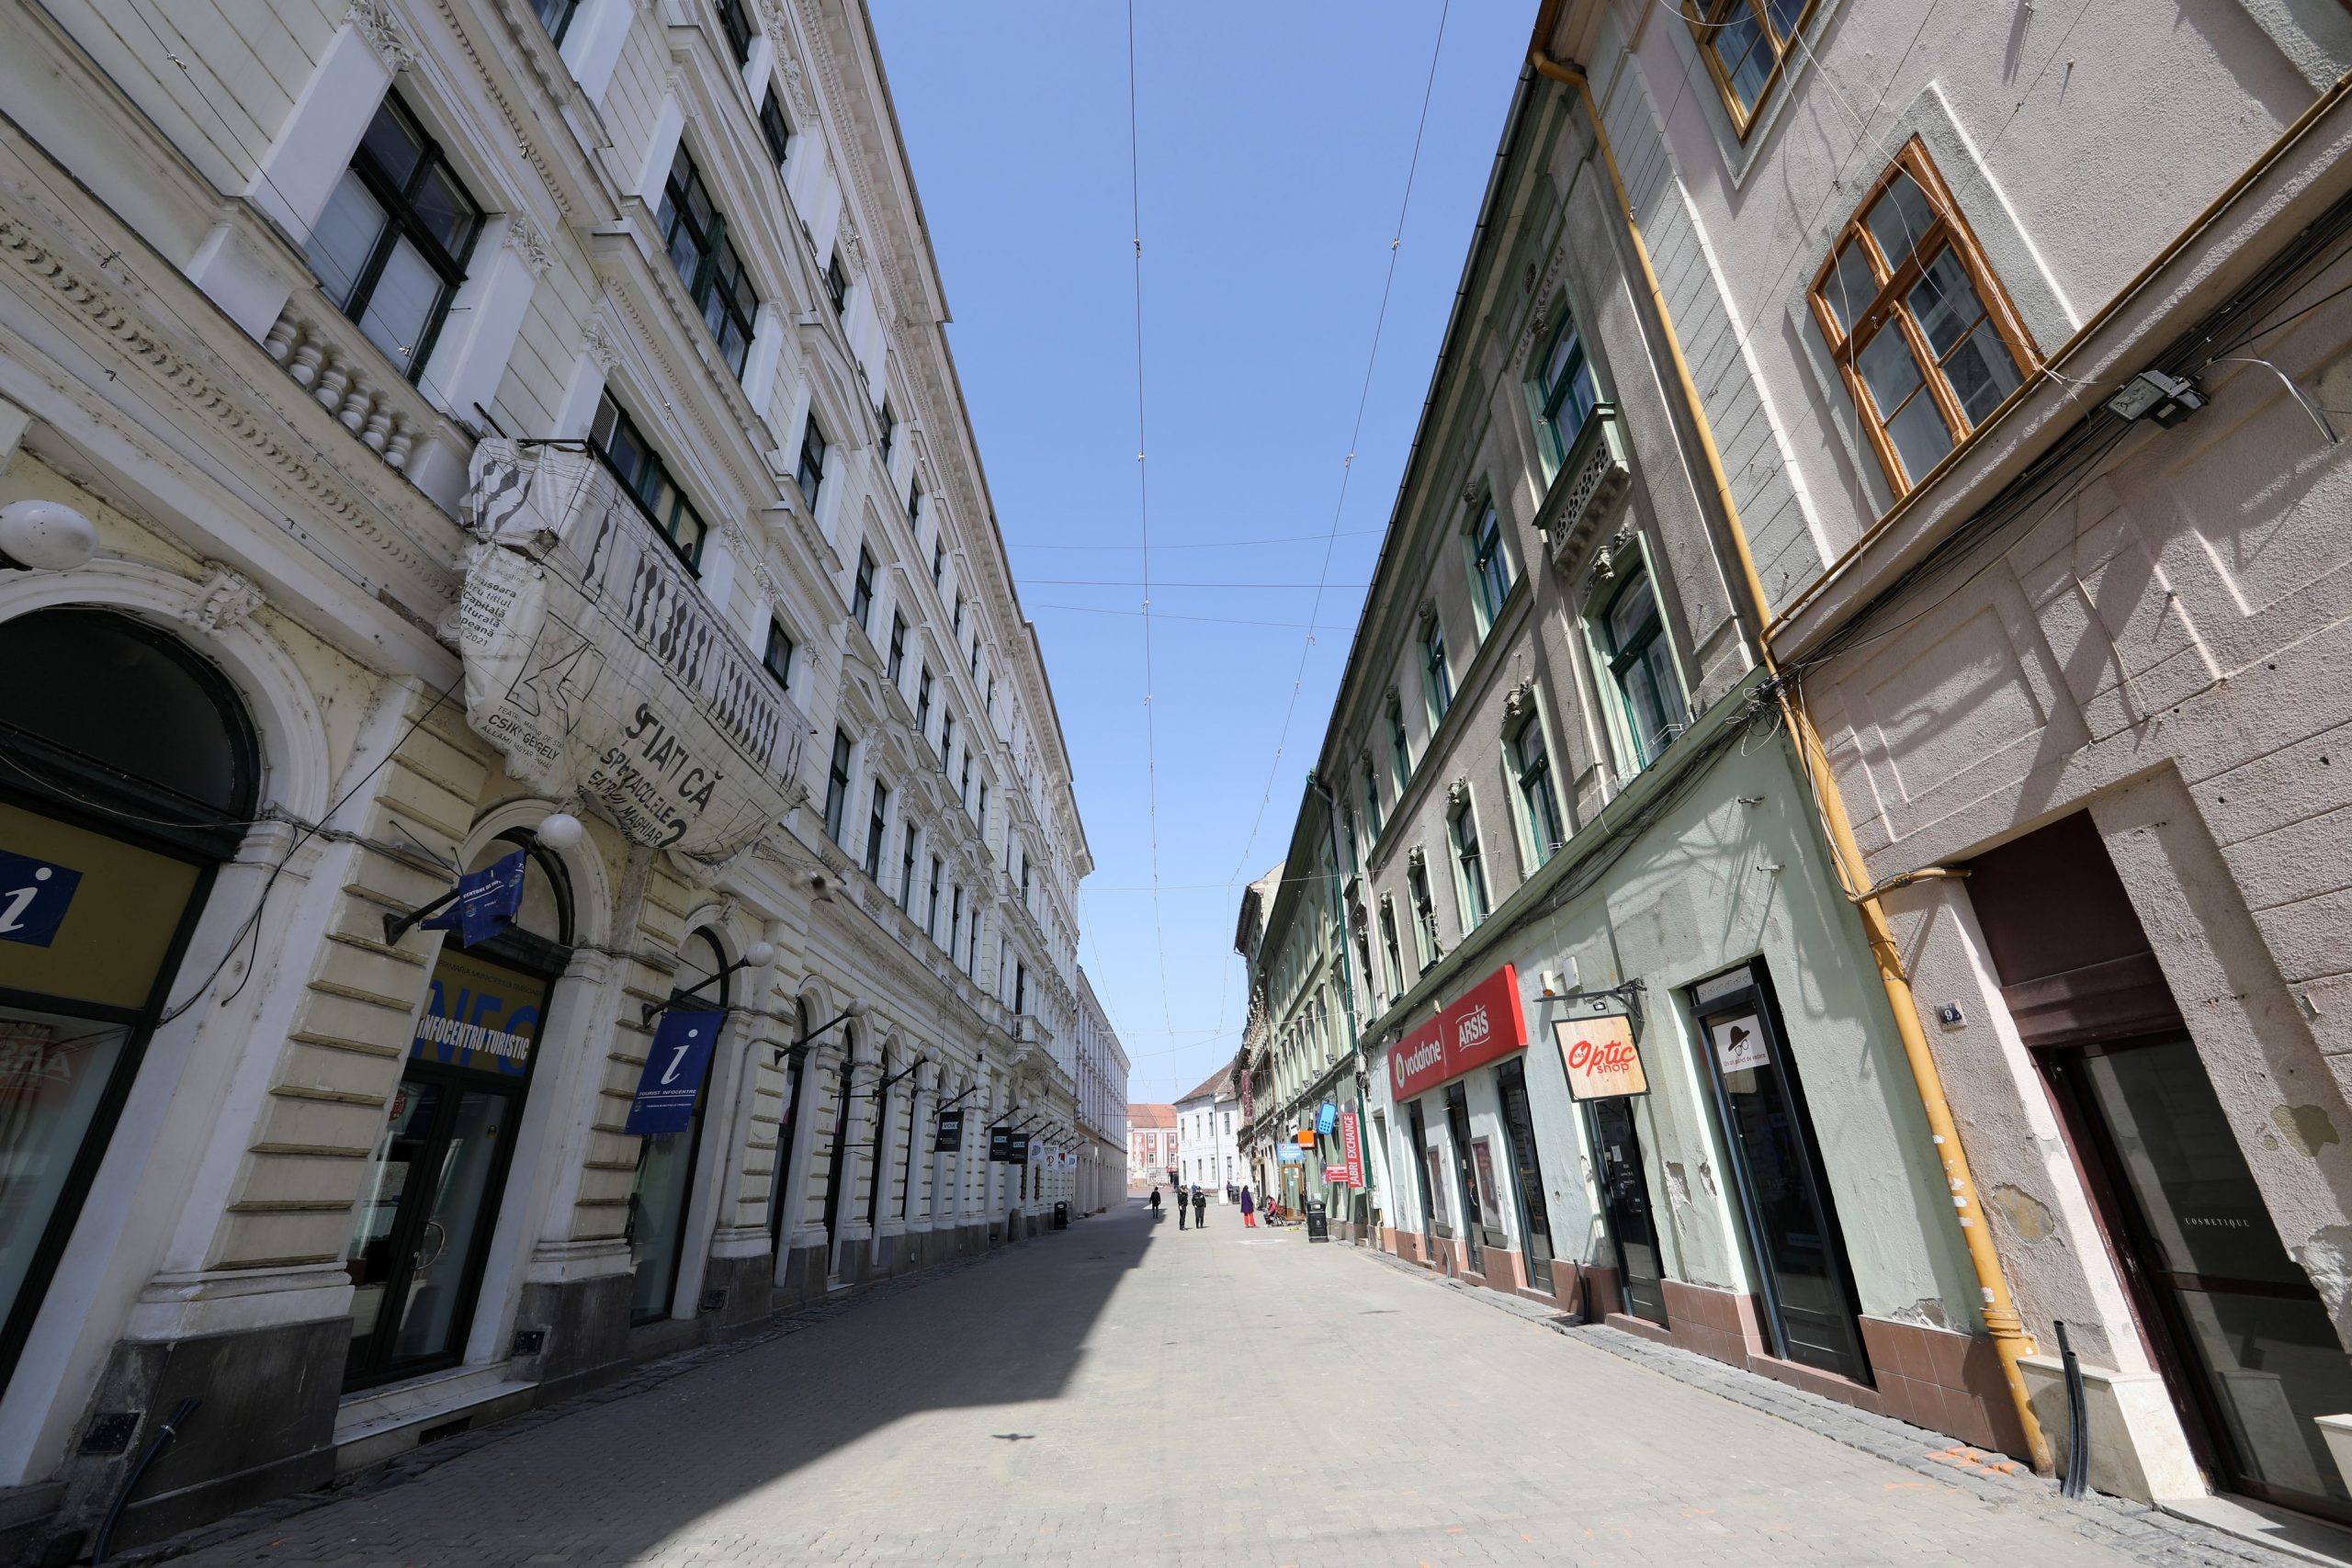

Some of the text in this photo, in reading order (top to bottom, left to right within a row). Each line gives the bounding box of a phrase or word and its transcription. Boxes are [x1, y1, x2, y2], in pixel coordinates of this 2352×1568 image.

[486, 592, 513, 608] titlul
[459, 604, 501, 628] ulturală
[465, 632, 489, 647] 2021
[622, 804, 663, 844] MAGHIAR
[1458, 1010, 1489, 1048] ARSIS
[1944, 1009, 1953, 1021] 9
[484, 1028, 530, 1060] TURISTIC
[1405, 1039, 1442, 1077] vodafone
[1568, 1040, 1636, 1077] Optic
[1597, 1062, 1630, 1074] shop
[1344, 1114, 1362, 1186] JABRI EXCHANGE
[2185, 1217, 2250, 1228] COSMETIQUE
